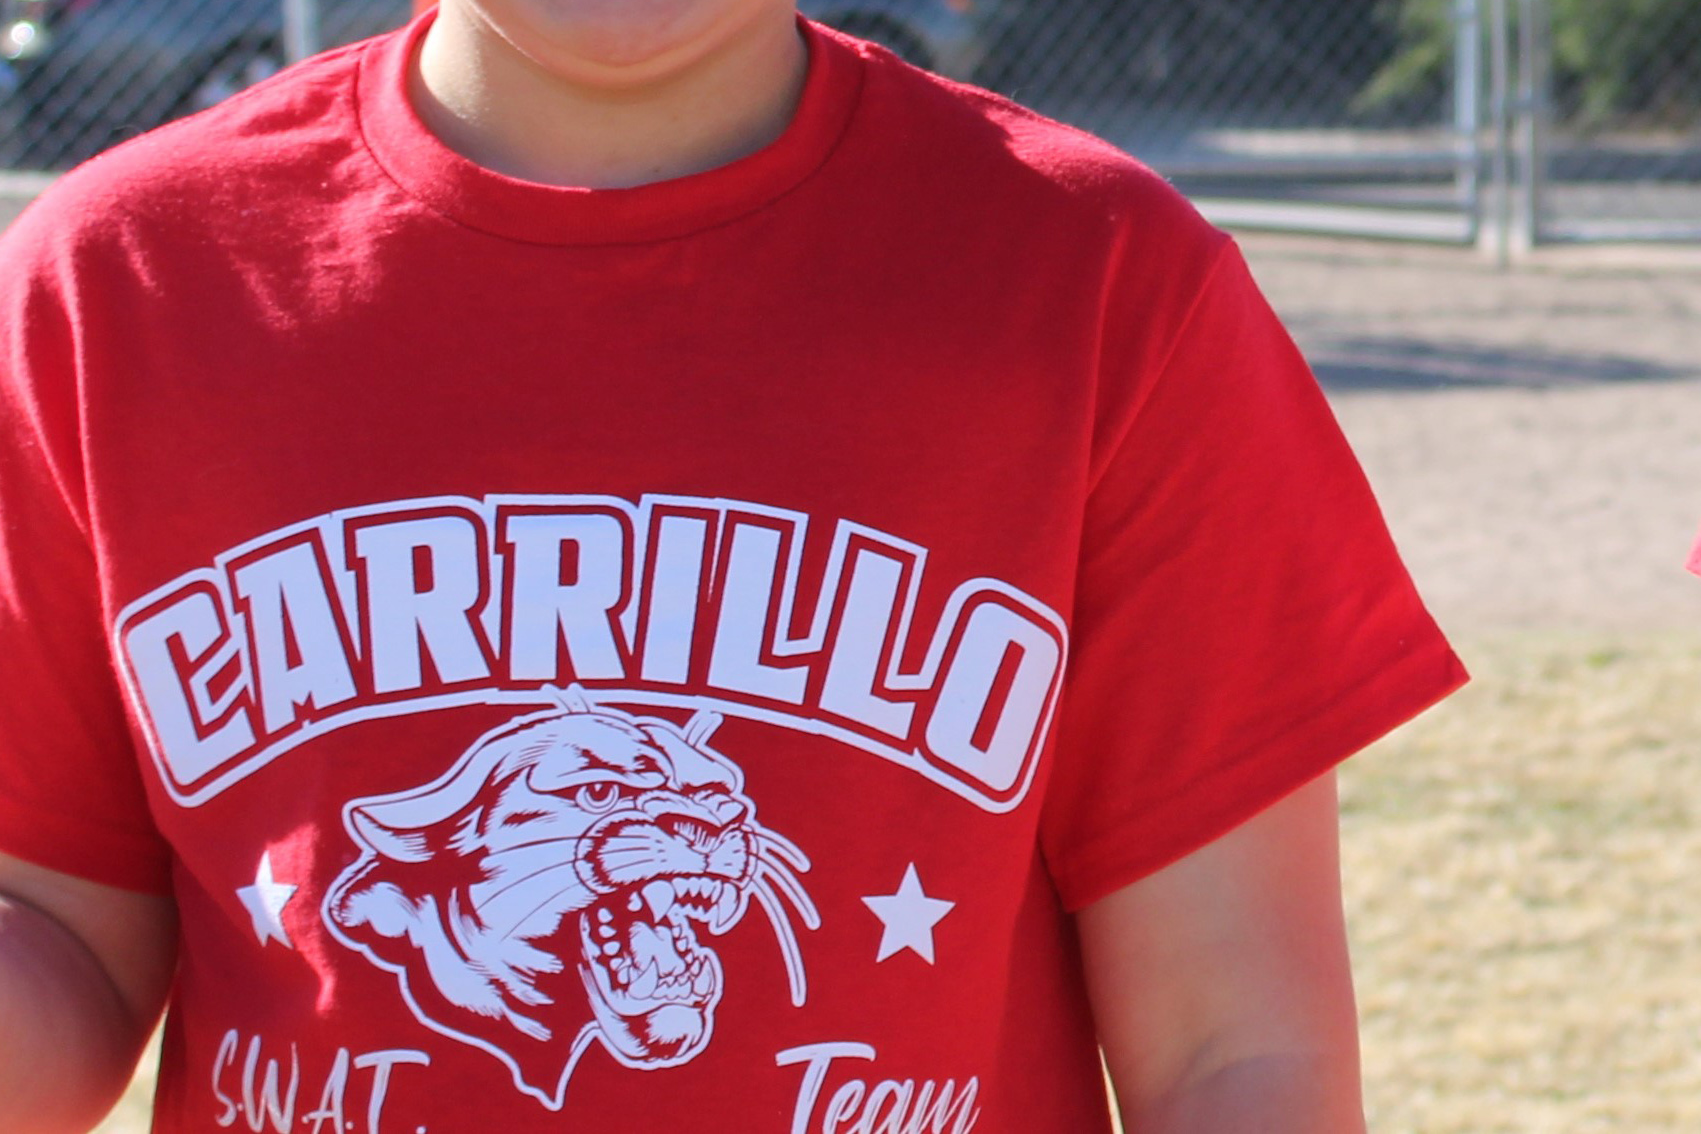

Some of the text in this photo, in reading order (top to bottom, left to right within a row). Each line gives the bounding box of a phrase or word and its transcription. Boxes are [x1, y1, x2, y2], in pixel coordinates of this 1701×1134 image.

[113, 494, 1069, 815] CARRILLO
[211, 1028, 982, 1134] S.W.A.T. Team
